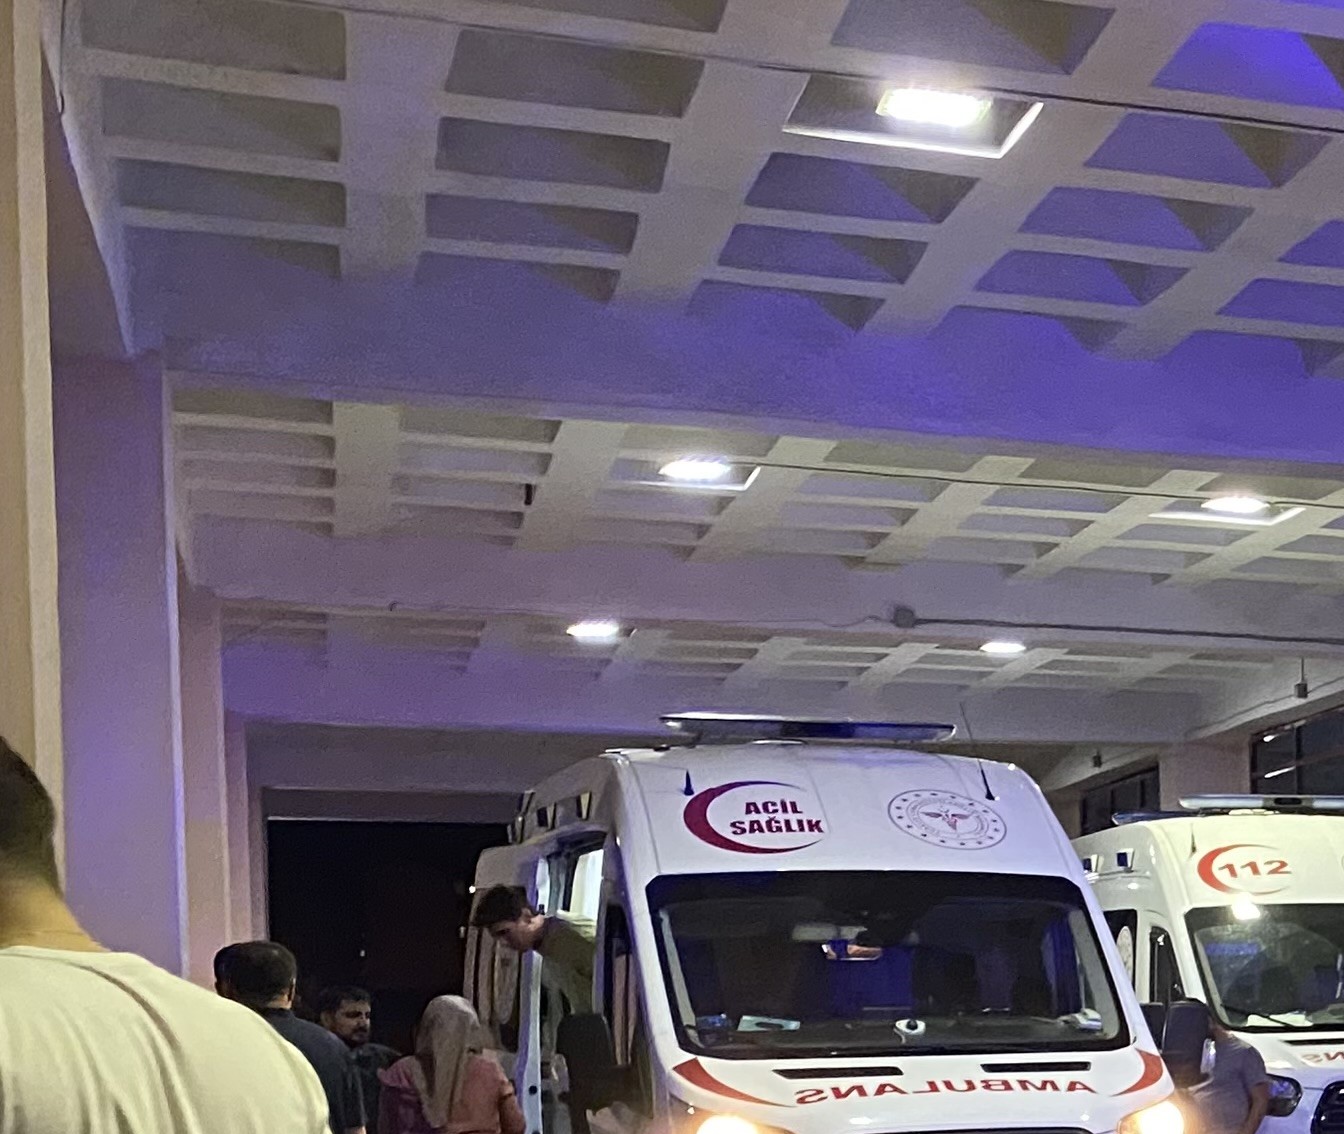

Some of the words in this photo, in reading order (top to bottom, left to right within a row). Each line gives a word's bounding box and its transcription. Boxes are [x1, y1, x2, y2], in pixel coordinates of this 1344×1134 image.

[744, 798, 804, 815] ACİL
[729, 815, 825, 835] SAĞLIK
[1217, 859, 1293, 879] 112
